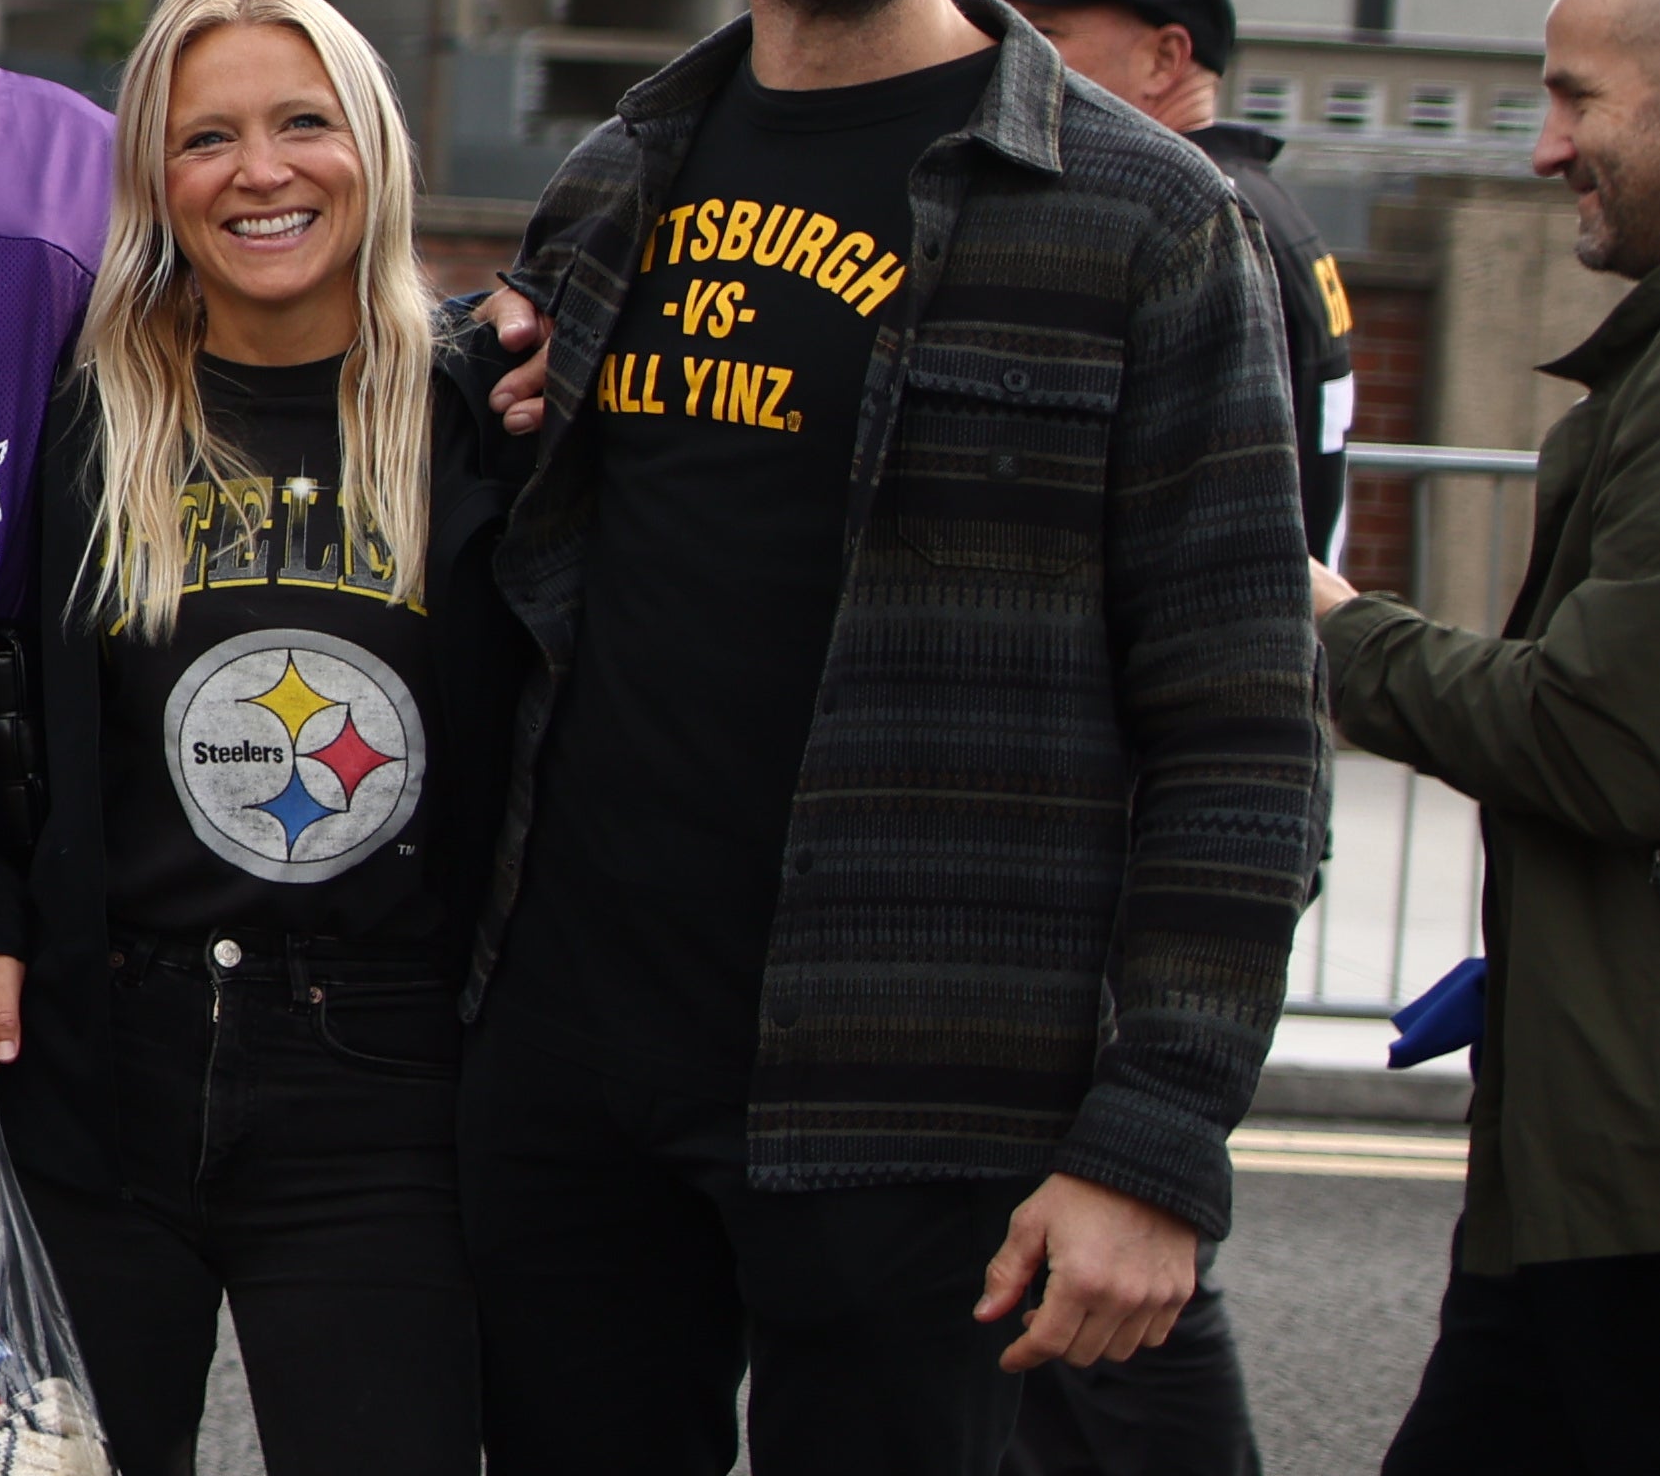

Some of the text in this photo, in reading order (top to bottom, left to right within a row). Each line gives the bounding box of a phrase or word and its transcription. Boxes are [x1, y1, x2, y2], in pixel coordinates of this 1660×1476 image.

[639, 197, 907, 318] TTSBURGH
[597, 352, 665, 414] ALL
[193, 739, 285, 765] Steelers
